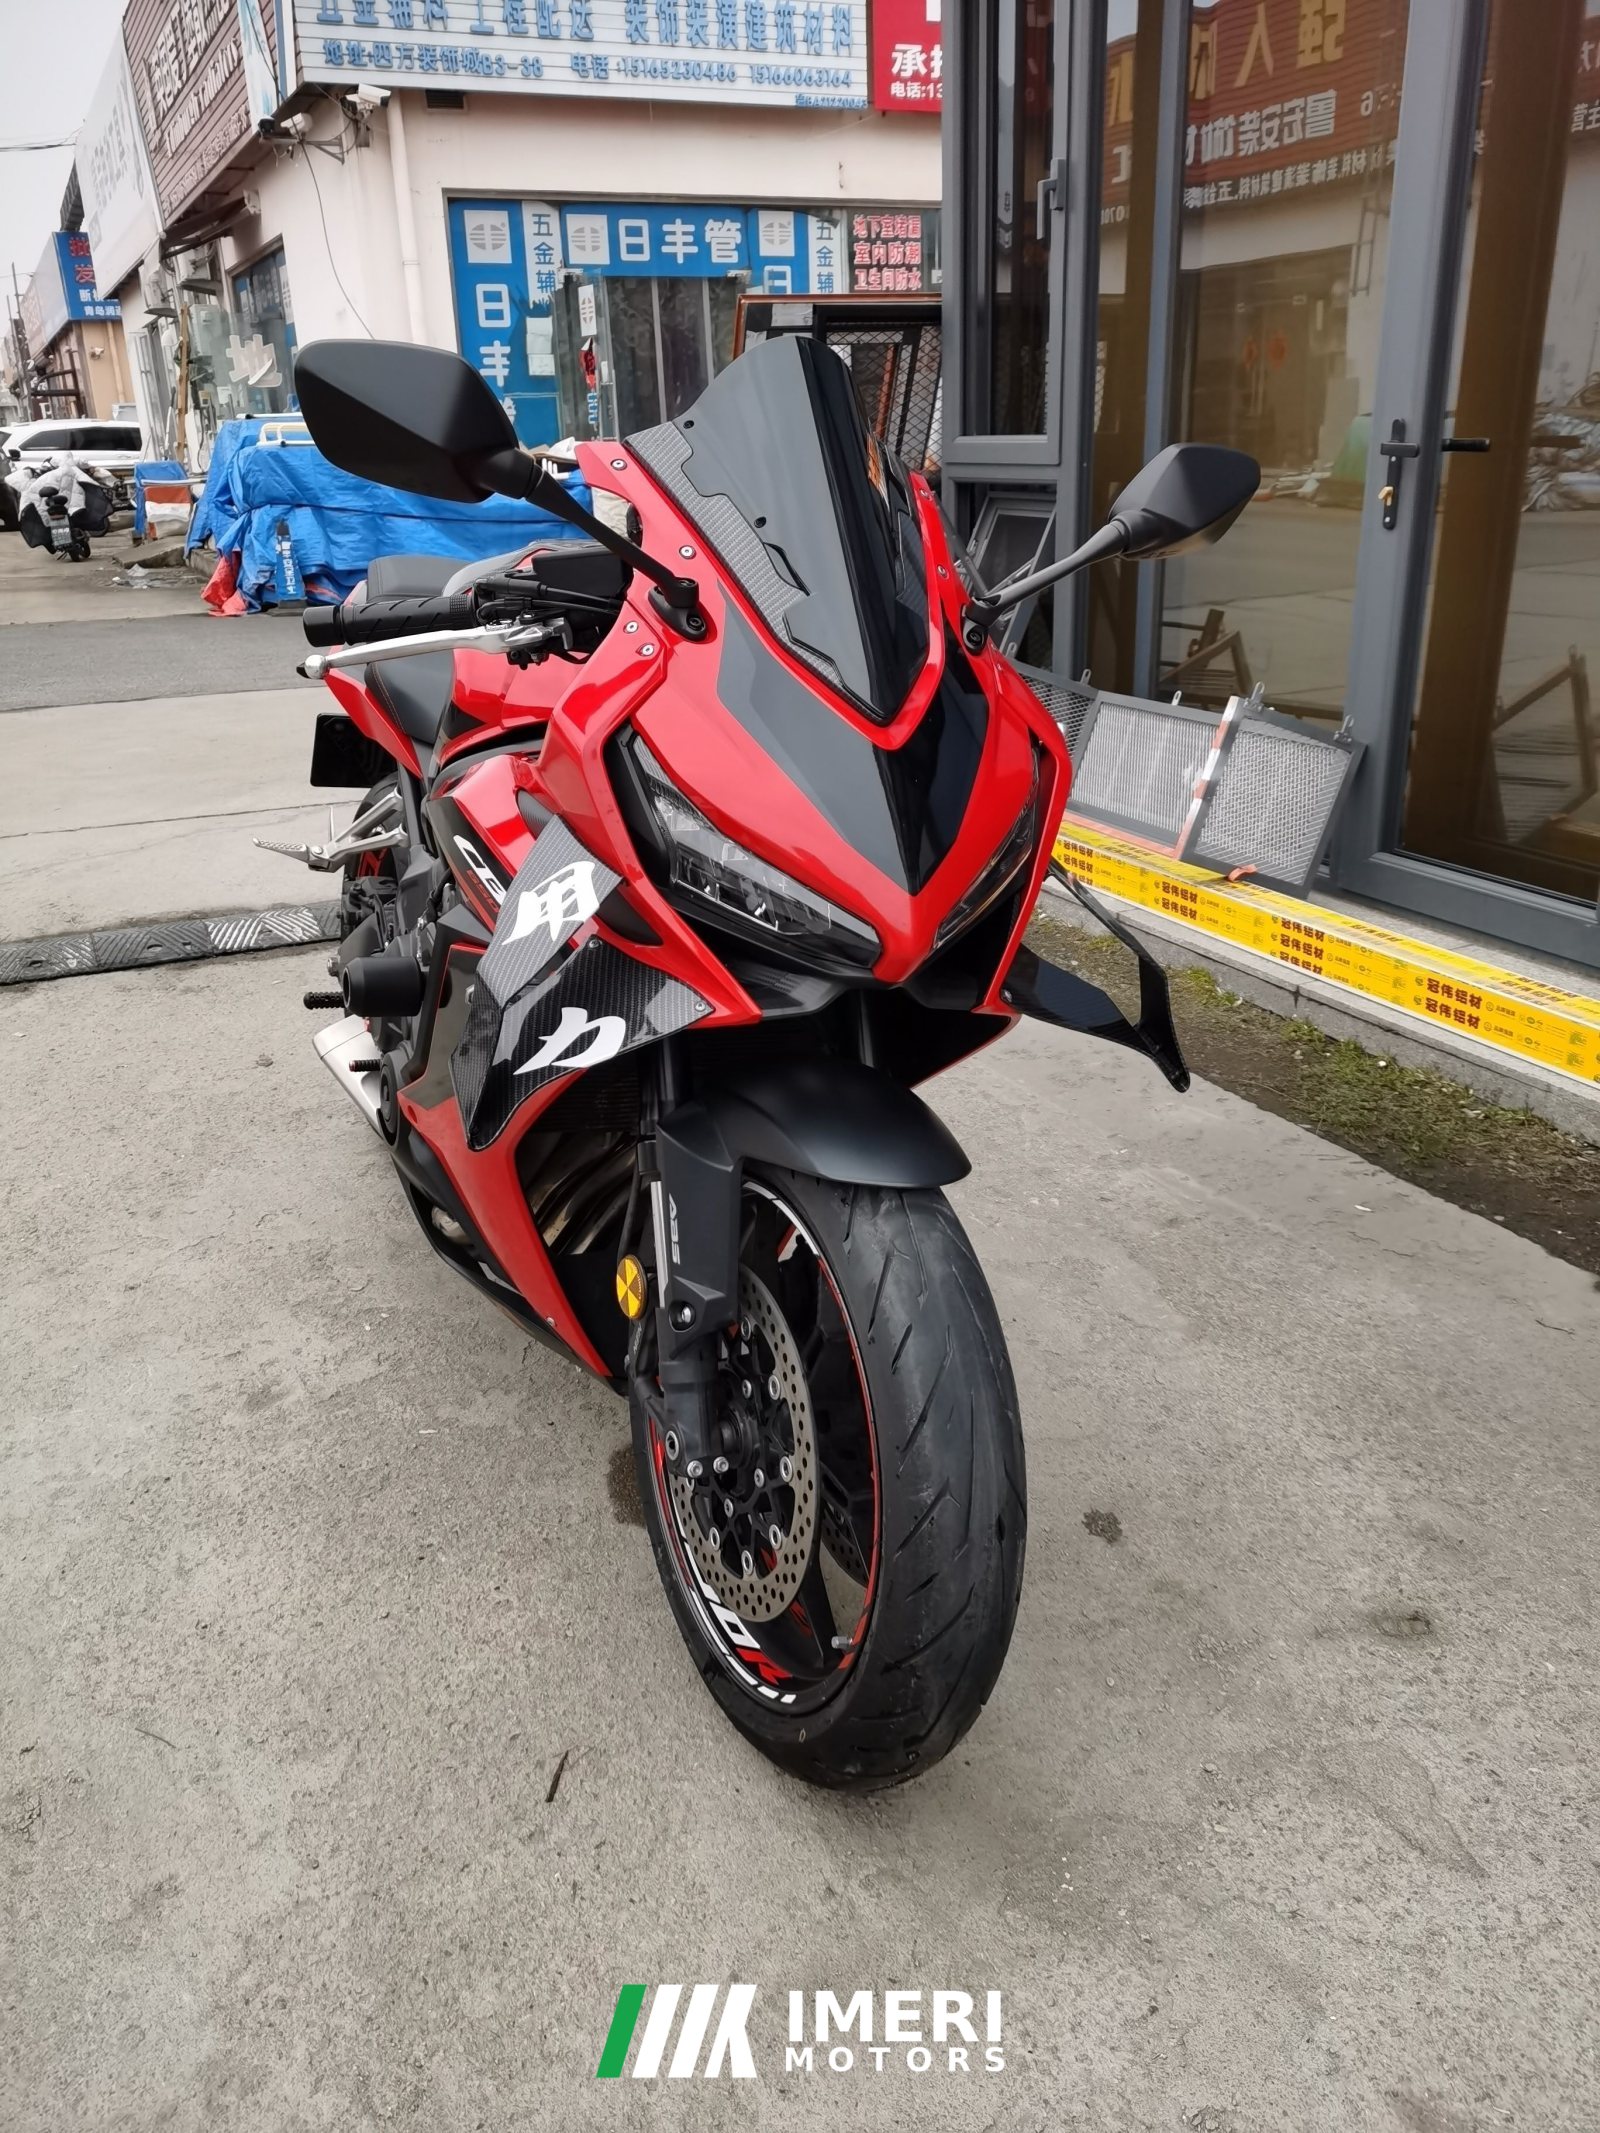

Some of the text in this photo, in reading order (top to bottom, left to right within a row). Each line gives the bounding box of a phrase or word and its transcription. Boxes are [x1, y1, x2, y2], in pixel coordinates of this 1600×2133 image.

[618, 218, 742, 264] 日丰管
[853, 241, 921, 265] 室内防潮
[532, 213, 557, 308] 五金辅
[854, 267, 922, 290] 卫生间防水
[1426, 977, 1483, 1010] 冠伟铝材
[1425, 997, 1480, 1030] 冠伟铝材
[669, 1193, 680, 1265] ABS
